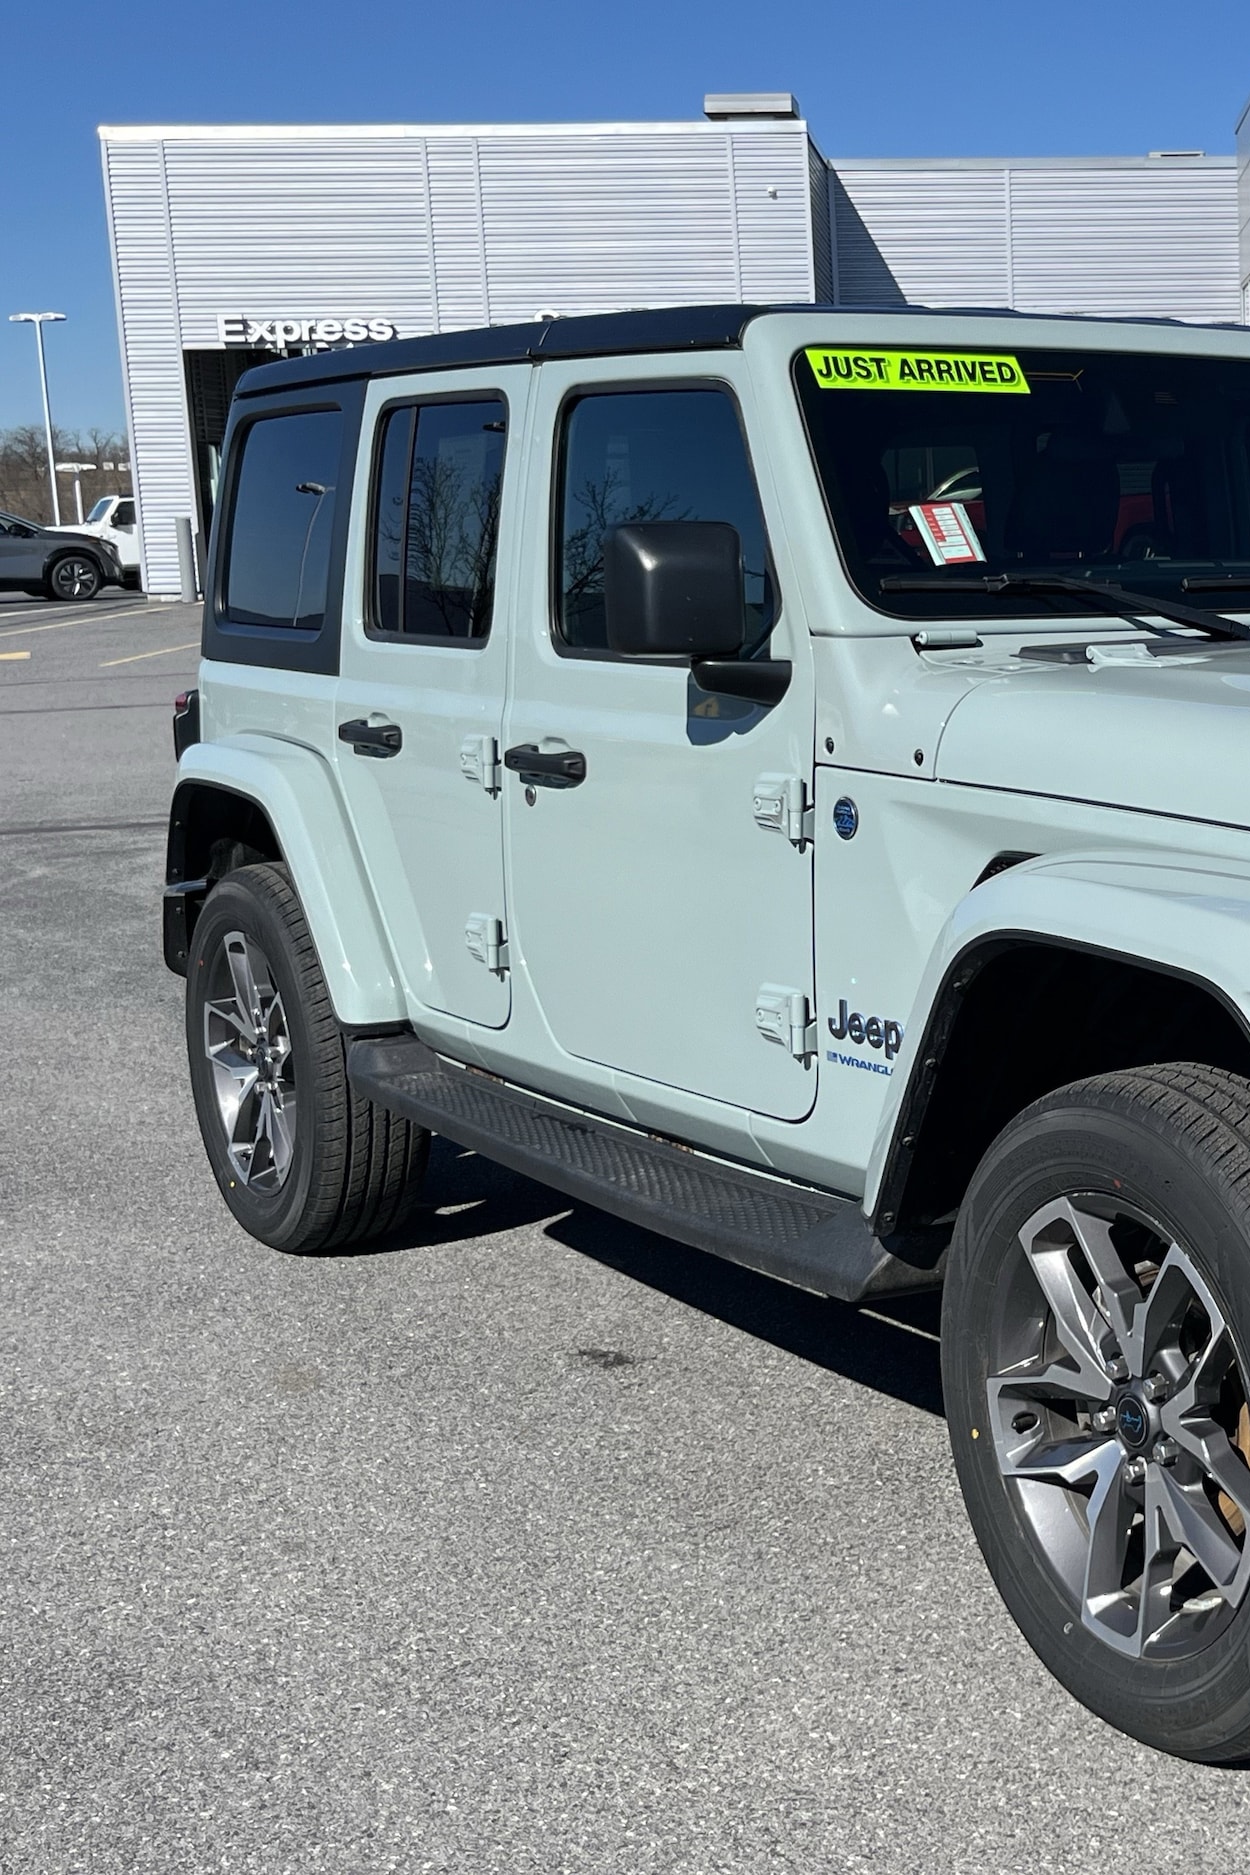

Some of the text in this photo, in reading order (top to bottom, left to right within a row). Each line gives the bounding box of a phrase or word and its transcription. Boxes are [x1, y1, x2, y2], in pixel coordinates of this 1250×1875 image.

[216, 313, 395, 349] Express
[817, 355, 1019, 386] JUST ARRIVED
[827, 998, 905, 1061] Jeep
[838, 1053, 894, 1077] WRANGL
